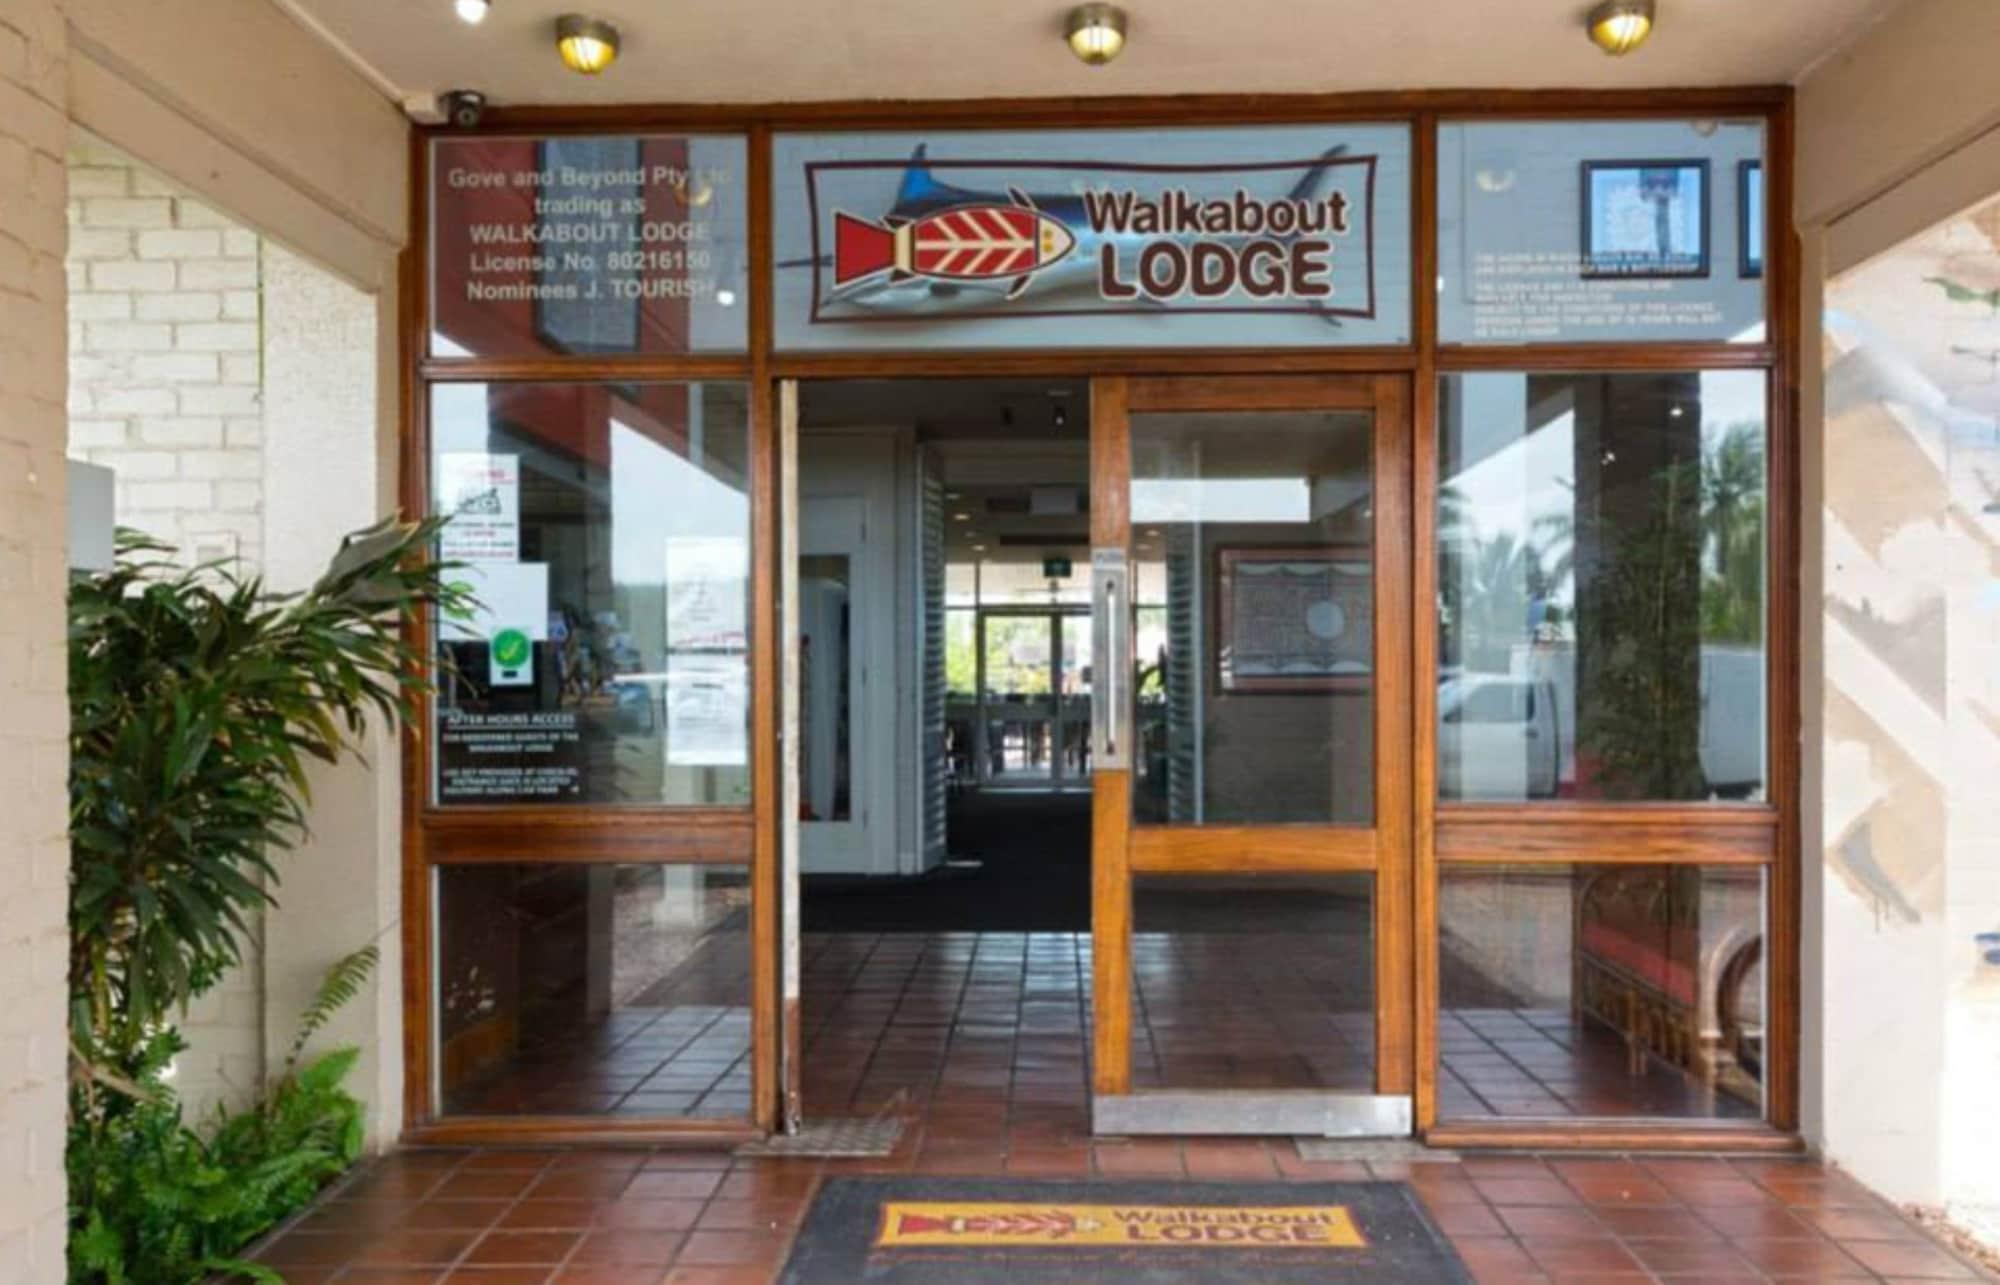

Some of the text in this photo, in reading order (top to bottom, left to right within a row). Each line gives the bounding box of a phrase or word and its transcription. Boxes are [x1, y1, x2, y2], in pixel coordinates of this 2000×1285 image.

[449, 167, 506, 188] Gove
[513, 167, 554, 186] and
[560, 166, 645, 190] Beyond
[653, 165, 686, 191] Pty
[535, 197, 647, 219] trading as
[1085, 190, 1347, 235] Walkabout
[469, 222, 709, 243] WALKABOUT LODGE
[470, 253, 556, 272] License
[1101, 240, 1332, 298] LODGE
[467, 280, 578, 300] Nominees
[1113, 1209, 1333, 1242] Walkabout LODGE
